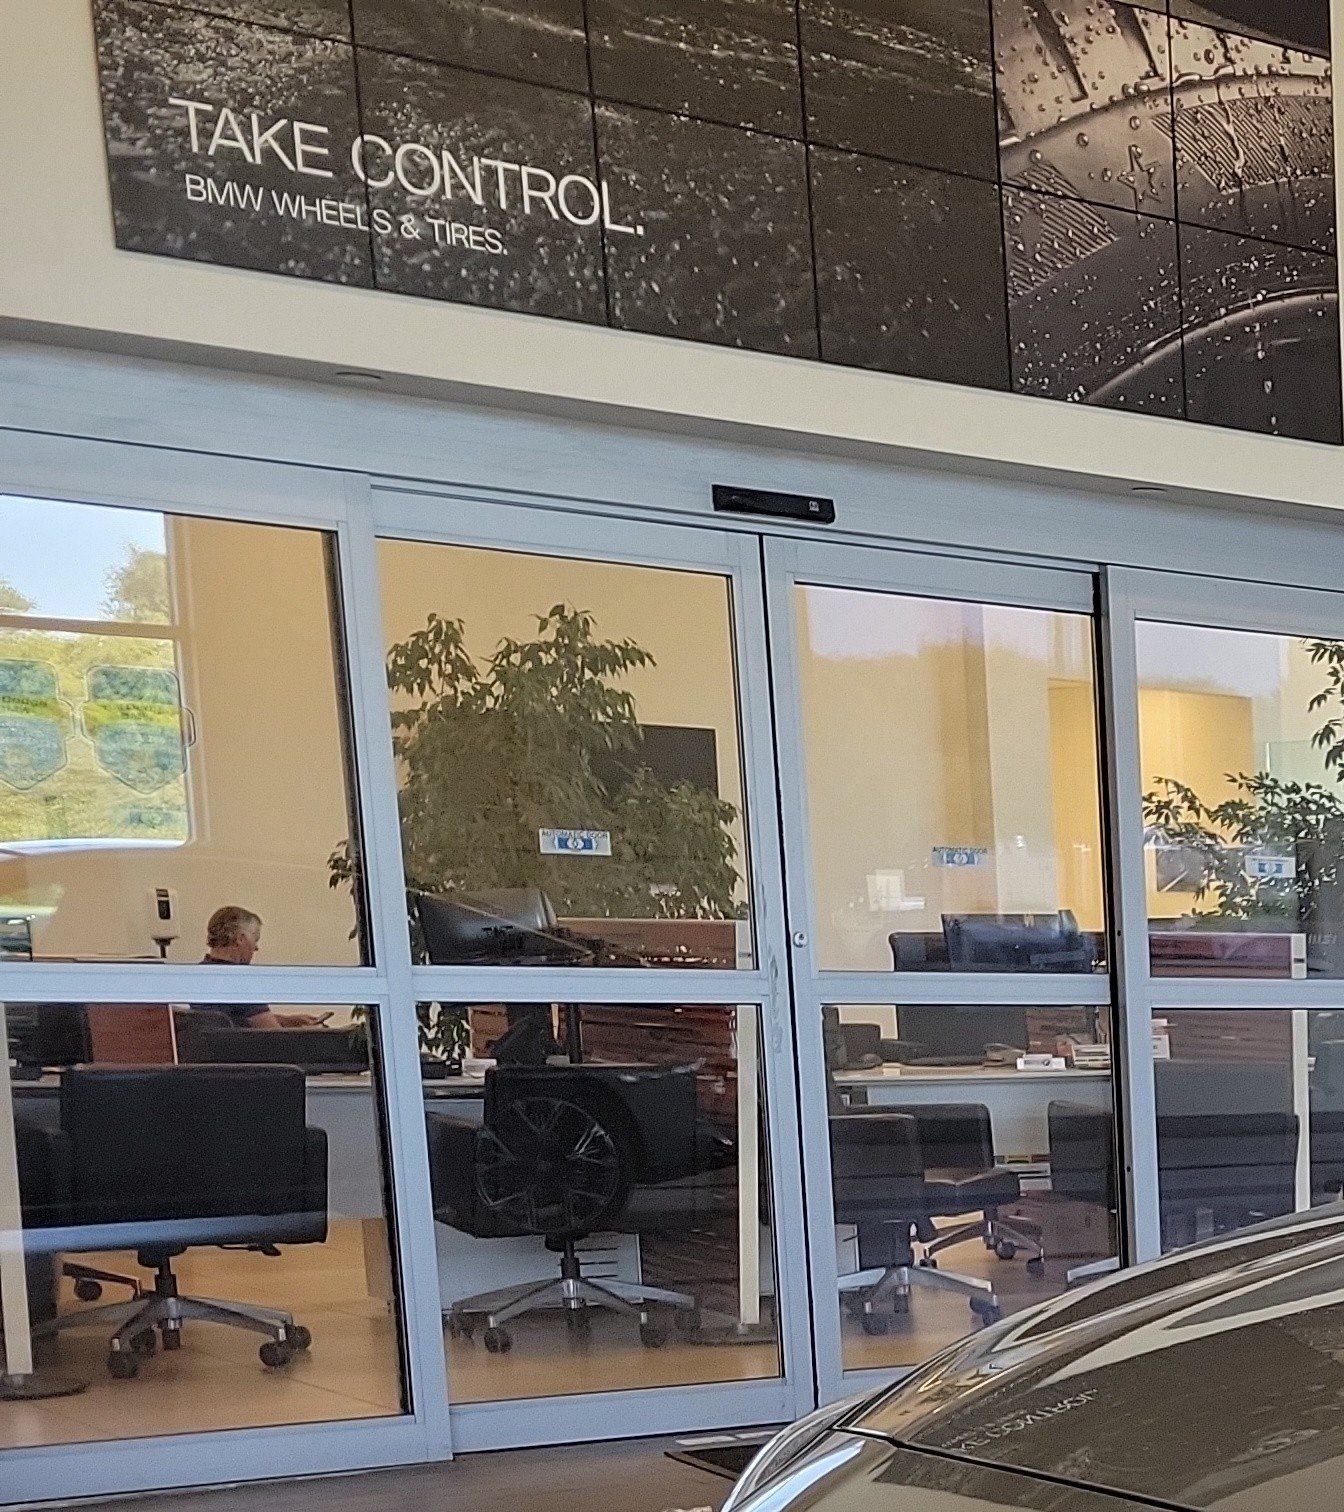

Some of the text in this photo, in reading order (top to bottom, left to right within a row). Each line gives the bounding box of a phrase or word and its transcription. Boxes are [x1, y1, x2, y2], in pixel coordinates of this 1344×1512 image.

[168, 97, 645, 237] TAKE CONTROL.
[185, 173, 509, 256] BMW WHEELS & TIRES.
